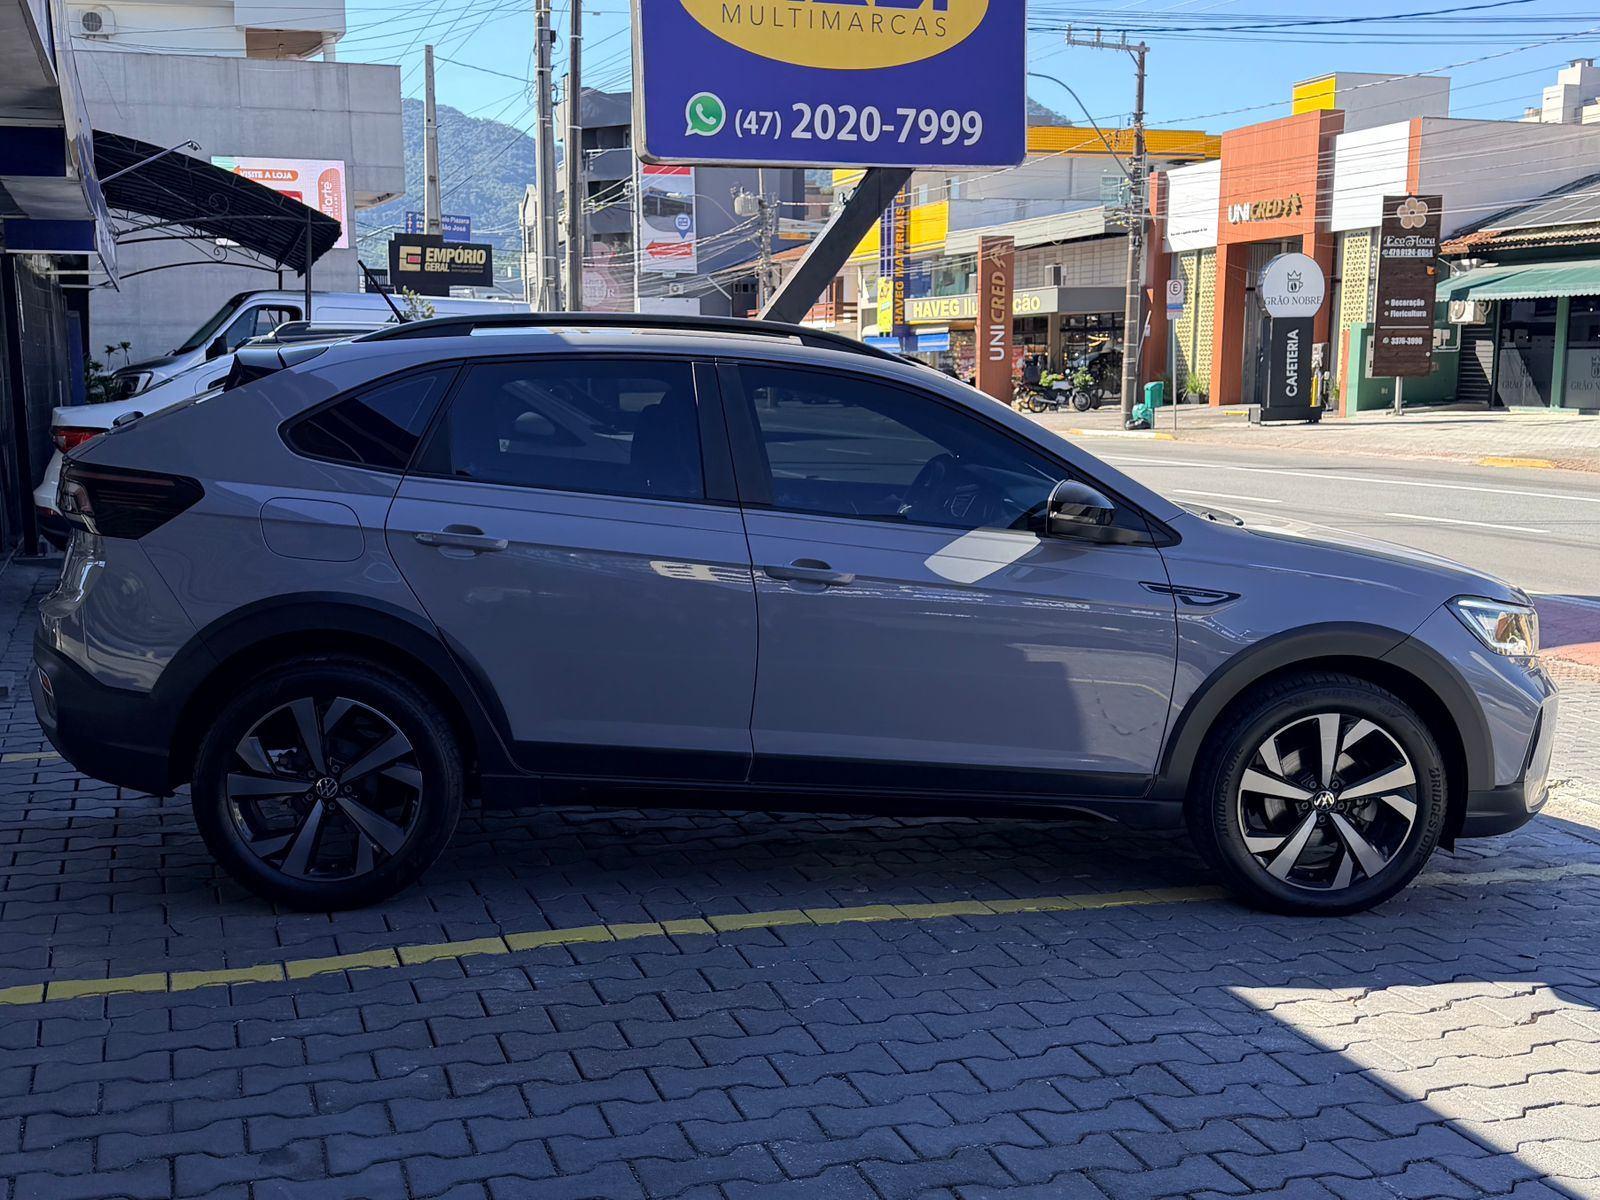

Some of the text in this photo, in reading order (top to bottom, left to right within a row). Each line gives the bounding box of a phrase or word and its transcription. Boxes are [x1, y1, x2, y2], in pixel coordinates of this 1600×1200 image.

[721, 3, 947, 37] MULTIMARCAS
[734, 102, 983, 146] (47) 2020-7999
[240, 169, 293, 180] VISITE A LOJA
[1228, 200, 1284, 223] UNICRED
[895, 207, 905, 278] MATERIAIS
[424, 262, 450, 272] GERAL
[425, 246, 487, 265] EMPÓRIO
[895, 281, 905, 325] HAVEG
[913, 294, 1041, 318] HAVEG Ilução
[1264, 295, 1322, 306] GRÃO NOBRE
[1390, 298, 1425, 308] Decoração
[990, 273, 1007, 361] UNICRED
[1390, 310, 1427, 318] Floricultura
[1285, 329, 1299, 397] CAFETERIA
